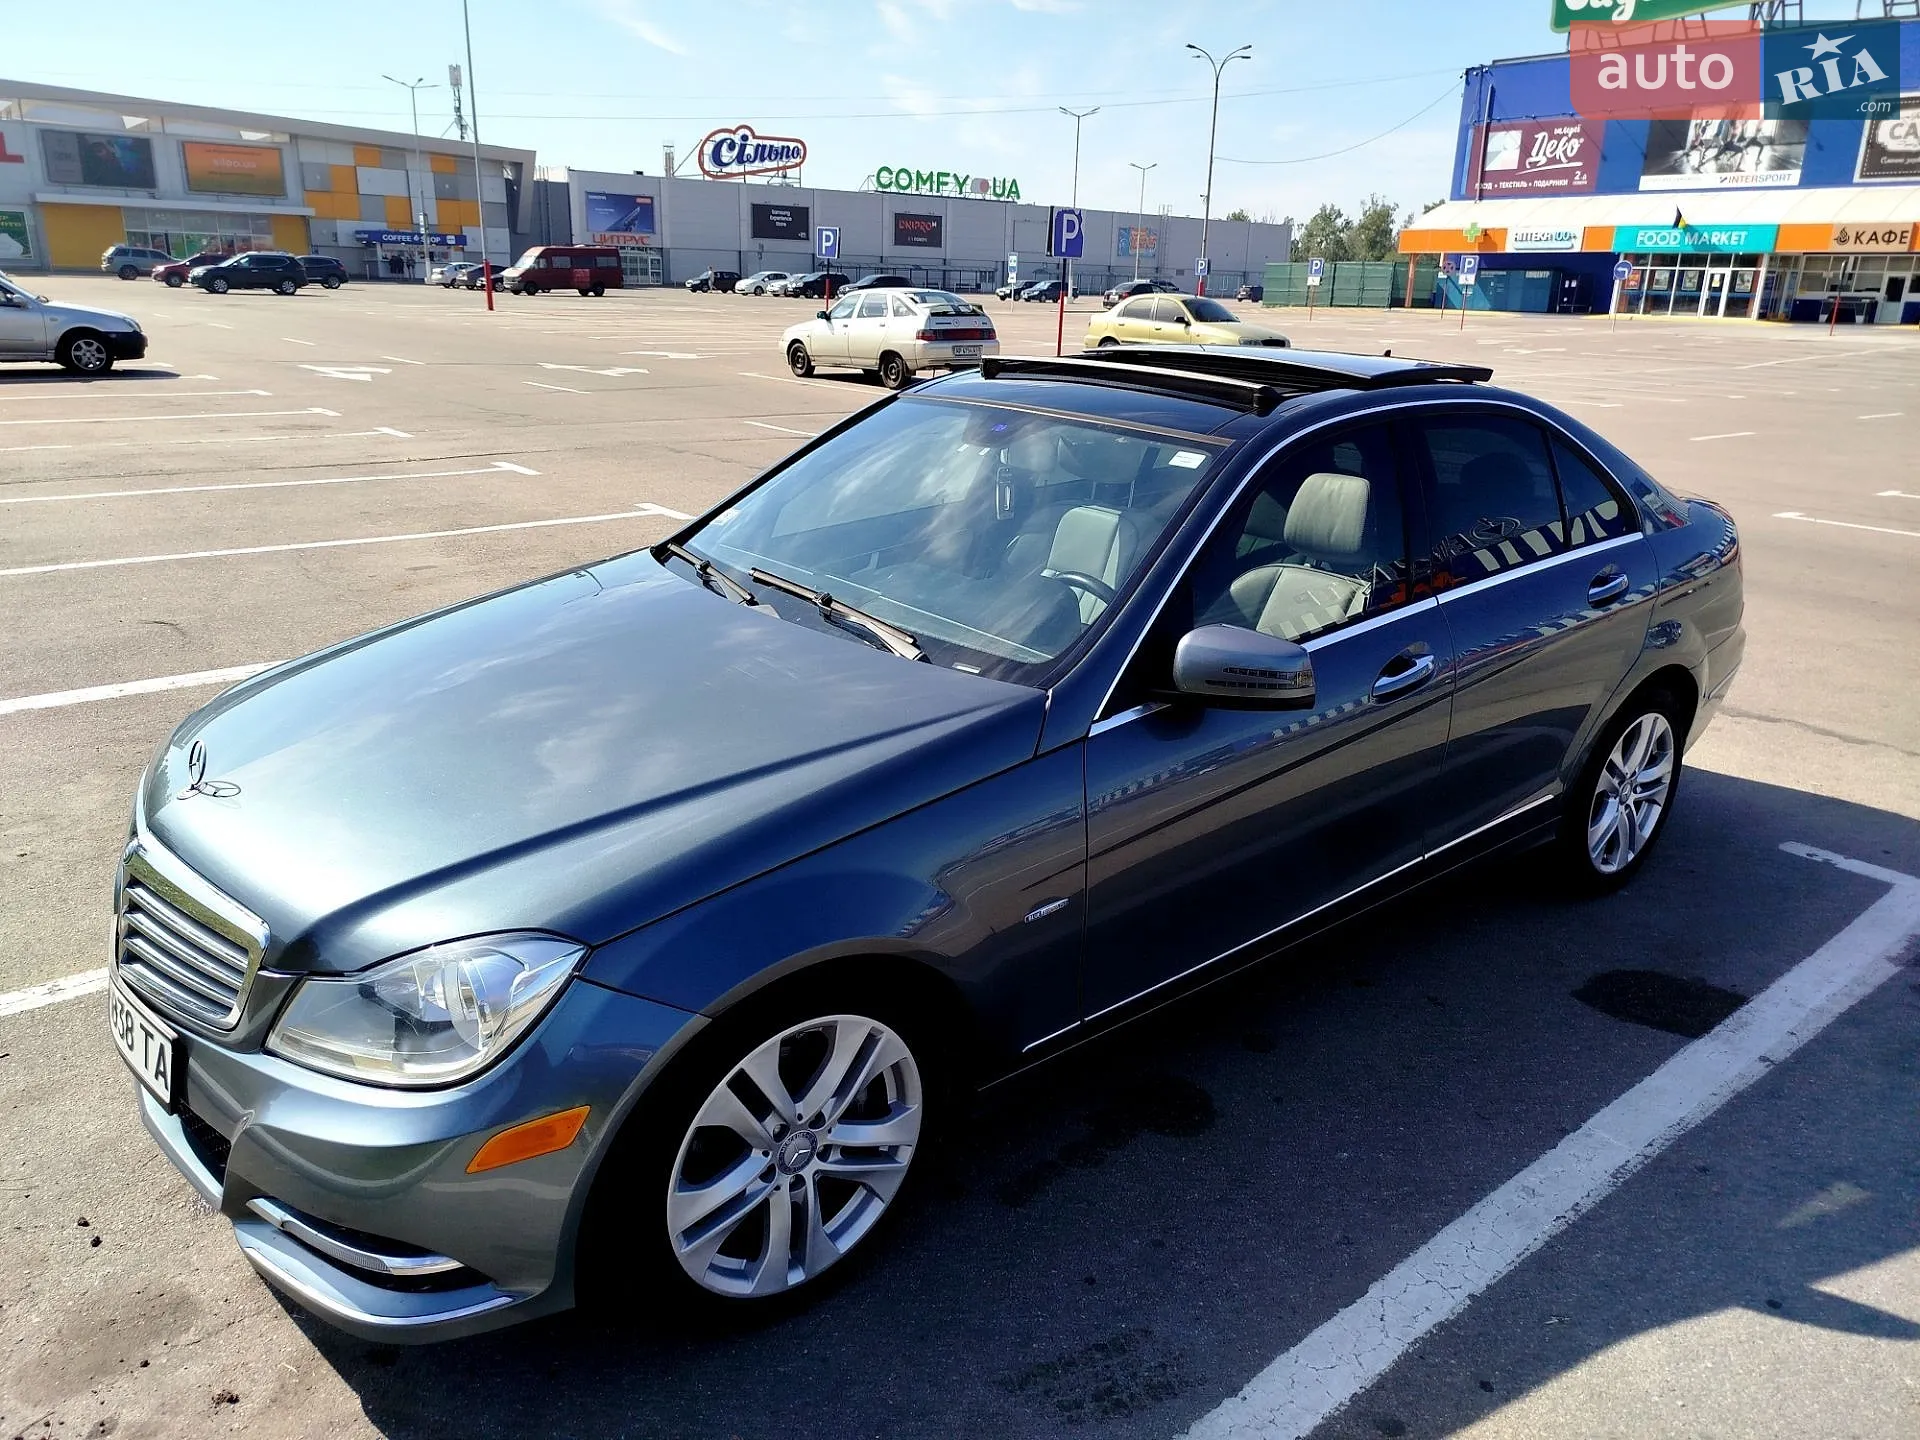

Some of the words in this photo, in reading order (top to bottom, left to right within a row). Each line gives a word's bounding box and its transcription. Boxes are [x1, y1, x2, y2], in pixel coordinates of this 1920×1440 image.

[711, 133, 800, 167] Сільпо
[876, 166, 970, 195] COMFY
[992, 177, 1021, 200] UA
[1728, 173, 1792, 184] INTERSPORT
[382, 234, 412, 242] COFFEE
[1061, 213, 1079, 253] P
[1637, 231, 1680, 245] FOOD
[1684, 230, 1749, 246] MARKET
[1853, 229, 1910, 245] КАФЕ
[821, 230, 834, 255] P
[1199, 260, 1206, 273] P
[1311, 260, 1321, 276] P
[1464, 257, 1474, 273] P
